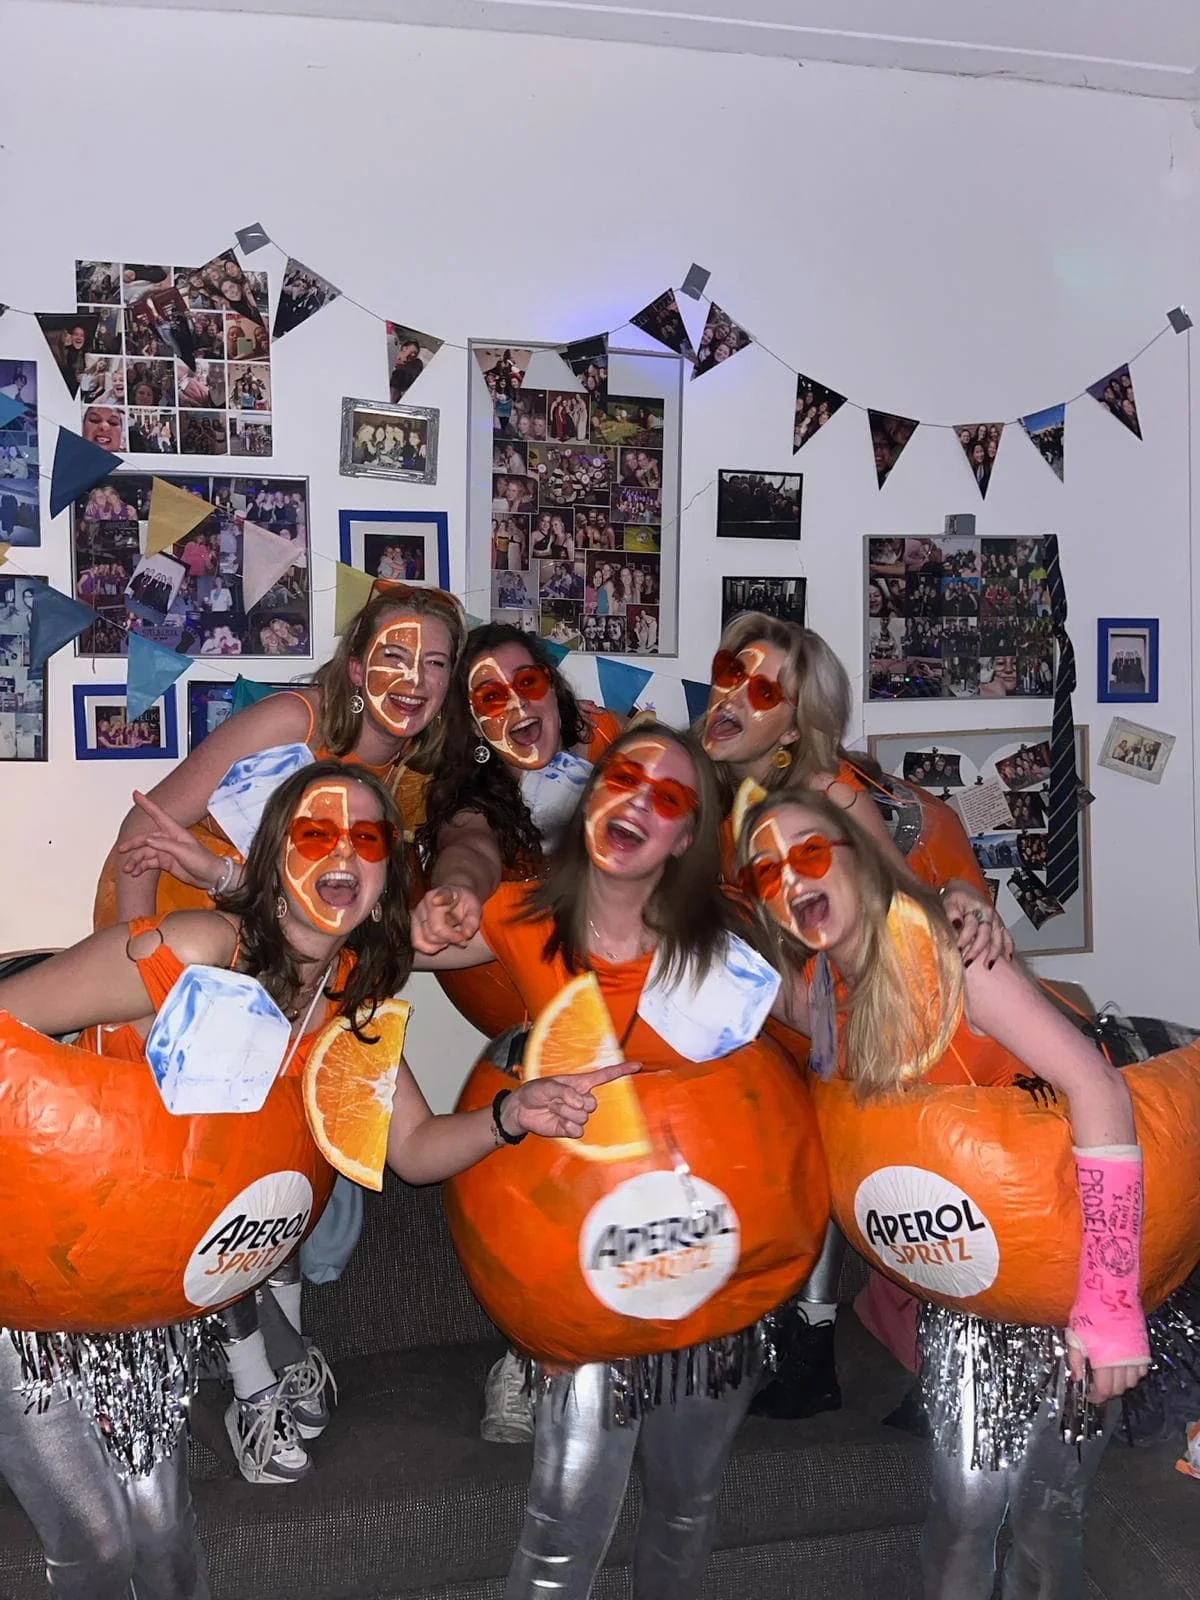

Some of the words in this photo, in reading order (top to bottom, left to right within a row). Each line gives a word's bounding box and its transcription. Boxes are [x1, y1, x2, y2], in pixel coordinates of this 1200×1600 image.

[198, 1209, 309, 1255] APEROL
[588, 1204, 737, 1269] APEROL
[866, 1199, 985, 1245] APEROL
